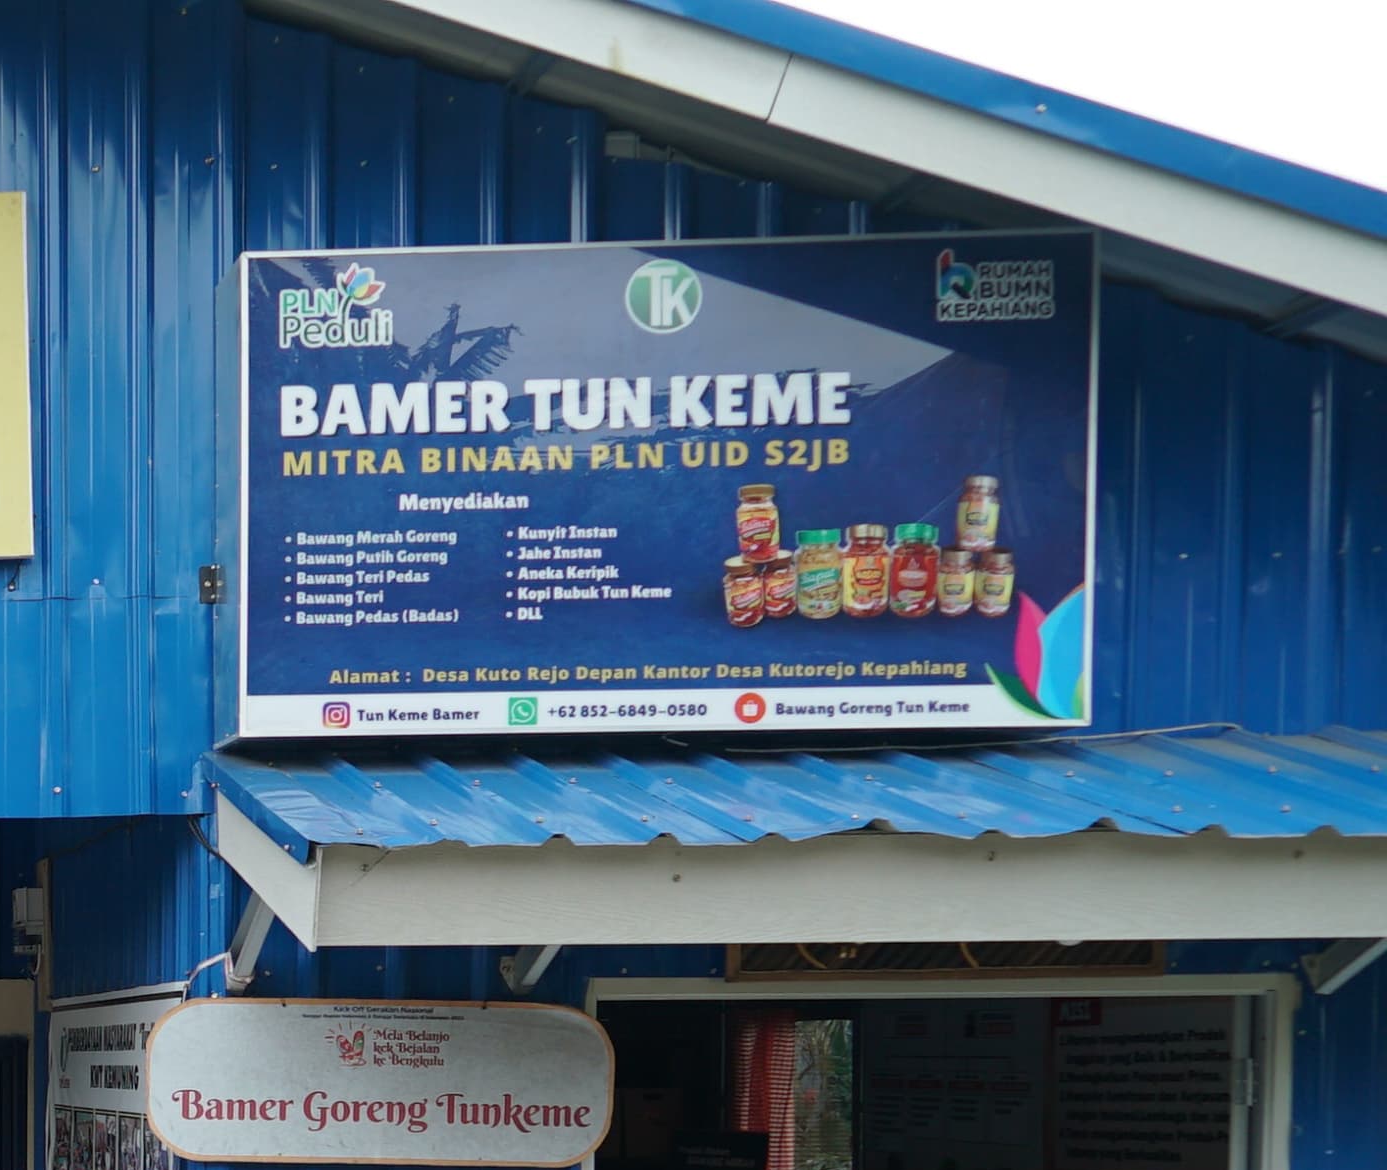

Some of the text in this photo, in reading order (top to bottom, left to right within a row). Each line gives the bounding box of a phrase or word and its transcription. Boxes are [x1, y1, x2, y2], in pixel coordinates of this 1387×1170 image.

[980, 262, 1051, 279] RUMAH
[980, 280, 1051, 298] BUMN
[281, 290, 336, 315] PLN
[939, 302, 1052, 318] KEPAHIANG
[281, 311, 392, 347] Peduli
[281, 372, 851, 437] BAMER TUN KEME
[283, 439, 850, 476] MITRA BINAAN PLN UID S2JB
[399, 494, 529, 513] Menyediakan
[297, 531, 457, 547] Bawang Merah Goreng
[518, 526, 617, 541] Kunyit Instan
[297, 551, 447, 566] Bawang Putih Goreng
[518, 546, 602, 560] Jahe Instan
[297, 570, 429, 586] Bawang Teri Pedas
[518, 566, 619, 581] Aneka Keripik
[296, 590, 384, 606] Bawang Teri
[518, 585, 672, 602] Kopi Bubuk Tun Keme
[296, 609, 459, 626] Bawang Pedas (Badas)
[517, 607, 543, 620] DLL
[329, 669, 399, 684] Alamat
[423, 668, 469, 682] Desa
[475, 668, 521, 681] Kuto
[528, 667, 570, 684] Rejo
[576, 666, 637, 684] Depan
[643, 665, 711, 680] Kantor
[716, 663, 763, 678] Desa
[769, 662, 856, 680] Kutorejo
[862, 660, 968, 680] Kepahiang
[357, 708, 480, 721] Tun Keme Bamer
[547, 706, 577, 718] +62
[776, 701, 970, 717] Bawang Goreng Tun Keme
[389, 1055, 444, 1068] Bengkulu
[171, 1089, 591, 1134] Bamer Goreng Tunkeme
